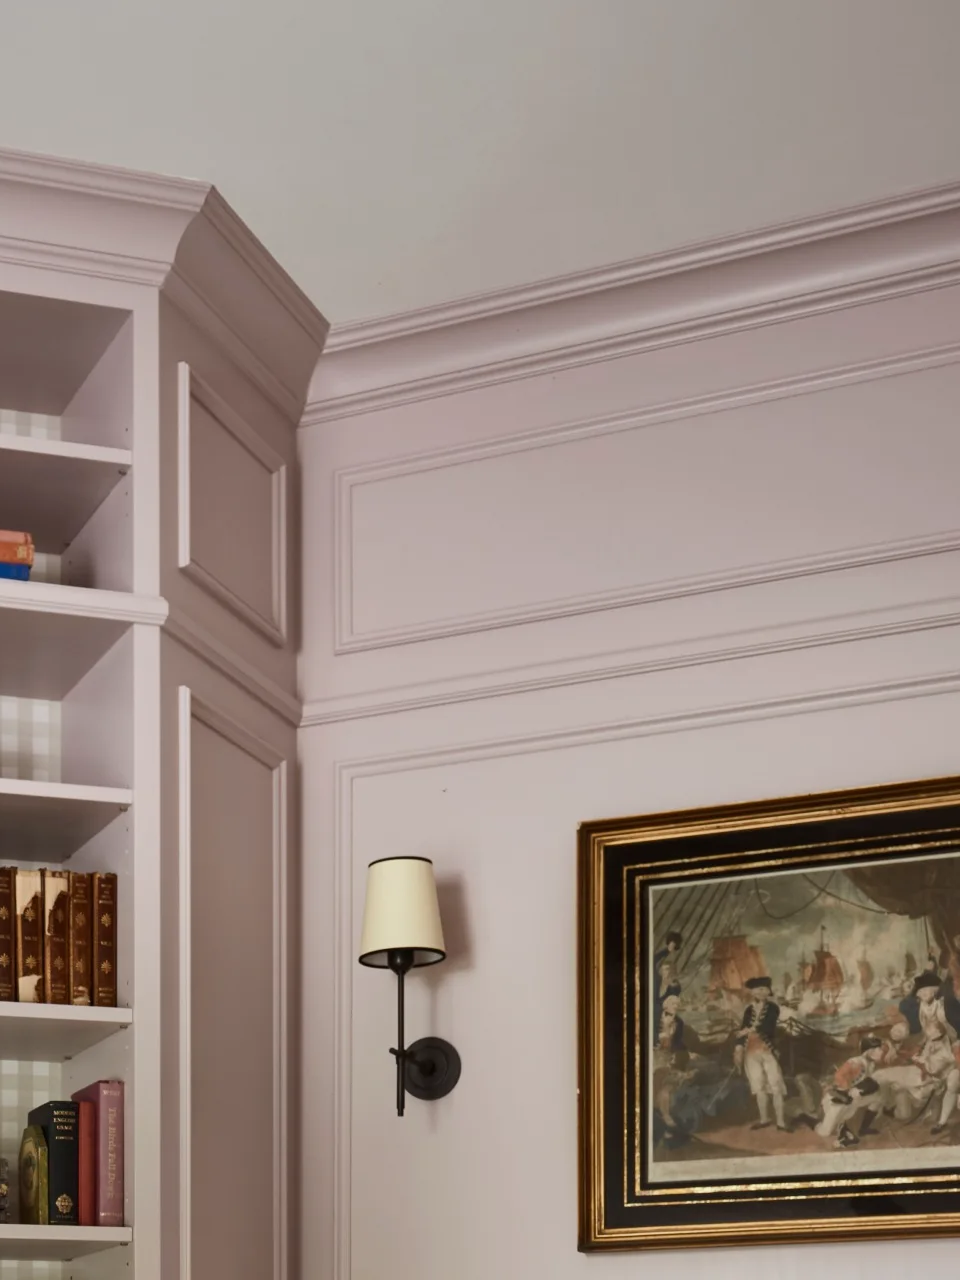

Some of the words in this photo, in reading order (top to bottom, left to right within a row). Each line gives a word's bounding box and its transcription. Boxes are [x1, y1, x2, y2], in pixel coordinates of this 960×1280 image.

[107, 1107, 117, 1127] The
[107, 1127, 117, 1149] Birds
[107, 1151, 117, 1171] Fall
